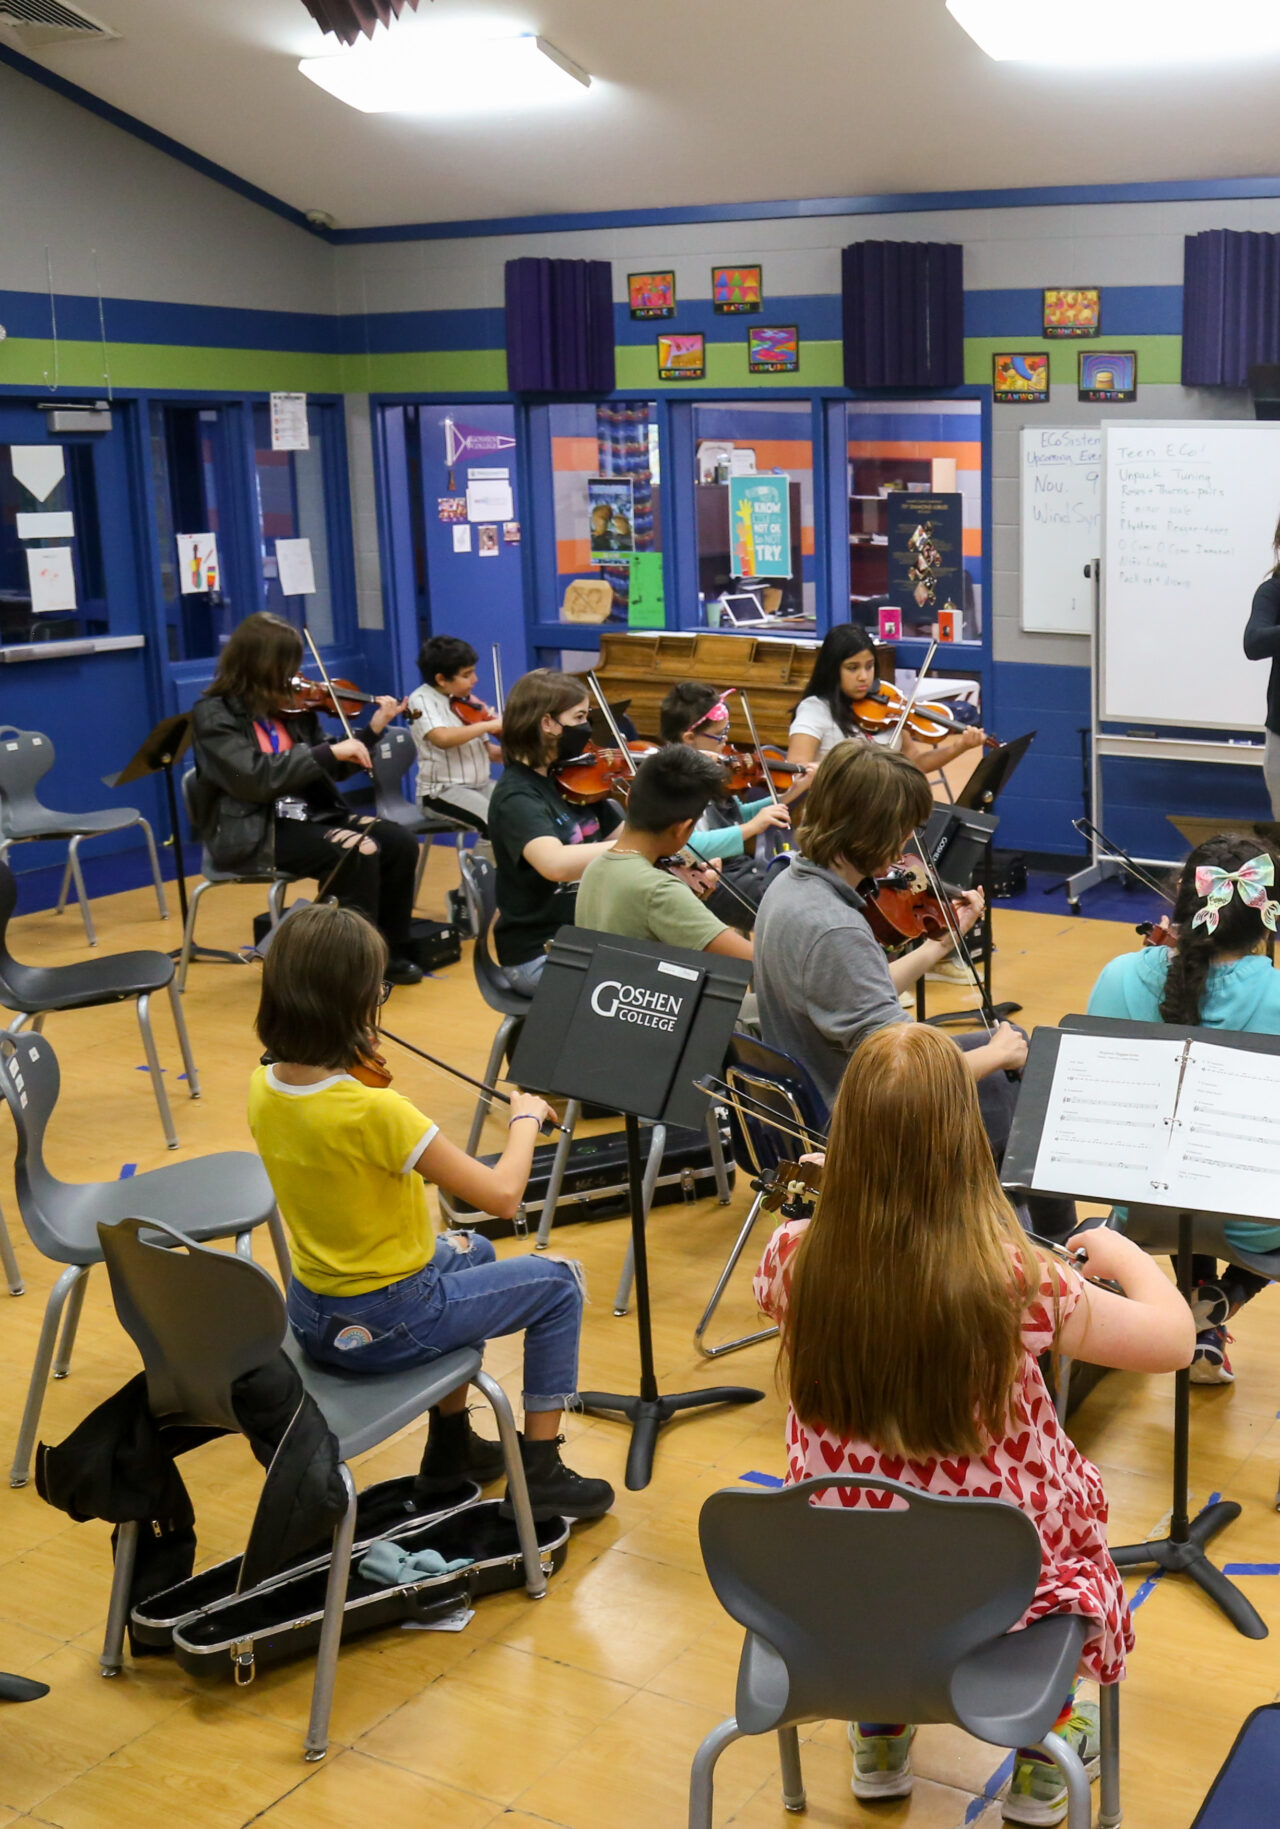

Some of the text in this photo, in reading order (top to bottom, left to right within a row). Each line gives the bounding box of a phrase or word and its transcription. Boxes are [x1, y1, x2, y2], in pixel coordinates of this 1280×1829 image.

[1047, 328, 1096, 336] COMMUNITY
[996, 393, 1046, 401] TEAMWORK
[1117, 447, 1156, 459] Teen
[1119, 469, 1212, 486] Unpack Tuning
[753, 502, 782, 513] KNOW
[754, 523, 782, 533] NOT OK
[755, 544, 782, 561] TRY.
[590, 980, 684, 1018] GOSHEN
[618, 1009, 676, 1033] COLLEGE
